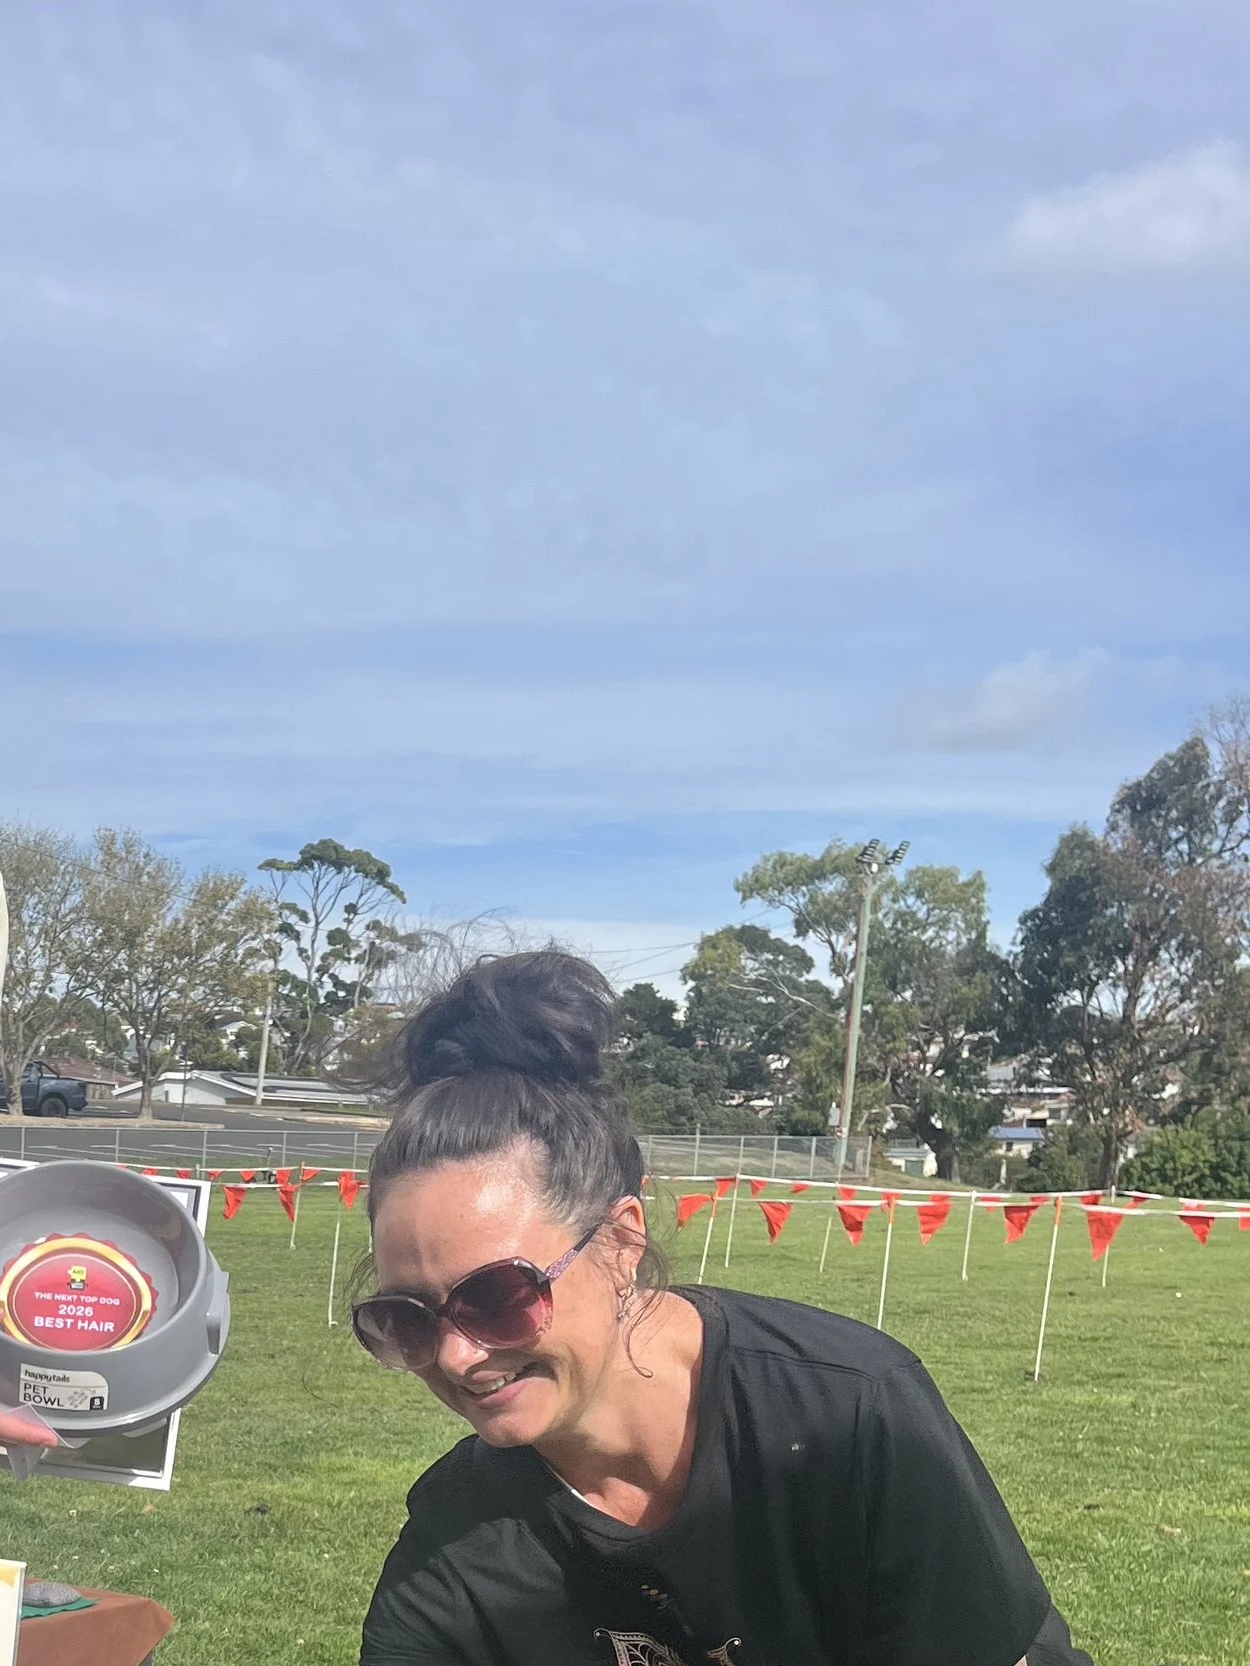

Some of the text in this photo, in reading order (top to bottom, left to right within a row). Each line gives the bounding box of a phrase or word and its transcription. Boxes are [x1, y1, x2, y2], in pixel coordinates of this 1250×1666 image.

[34, 1291, 120, 1306] THE NEXT TOP DOG
[58, 1304, 94, 1317] 2026
[34, 1316, 115, 1332] BEST HAIR
[24, 1382, 50, 1395] PET
[23, 1393, 65, 1407] BOWL
